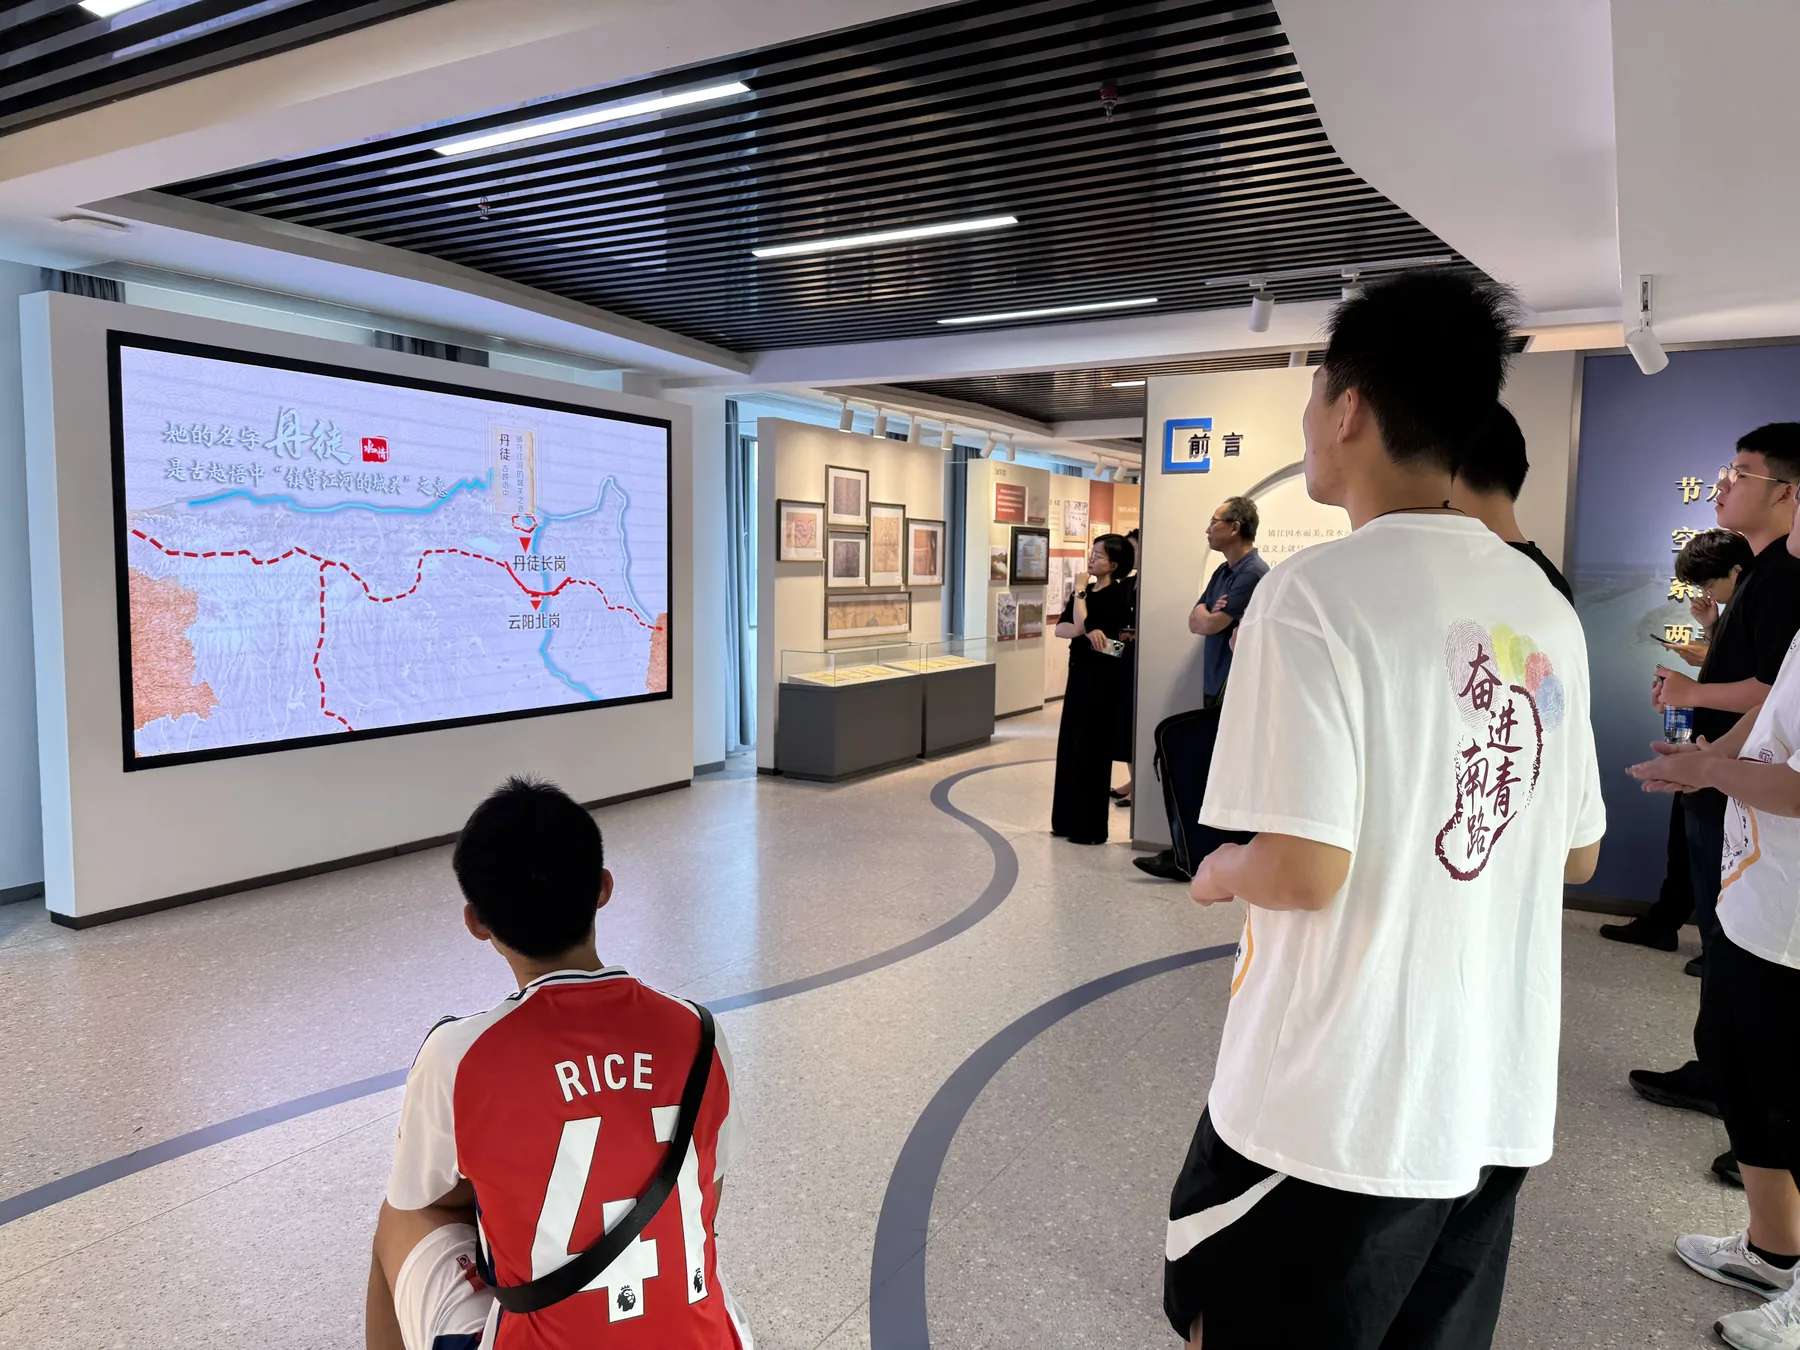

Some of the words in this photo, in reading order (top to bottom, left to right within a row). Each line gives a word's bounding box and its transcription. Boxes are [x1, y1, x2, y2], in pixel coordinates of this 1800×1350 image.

[164, 421, 262, 450] 她的名字
[265, 407, 352, 464] 丹徒
[499, 433, 511, 461] 丹徒
[1188, 432, 1243, 457] 前言
[513, 555, 566, 572] 丹徒长岗
[508, 613, 560, 630] 云阳北岗
[554, 1052, 653, 1102] RICE
[530, 1105, 708, 1323] 41
